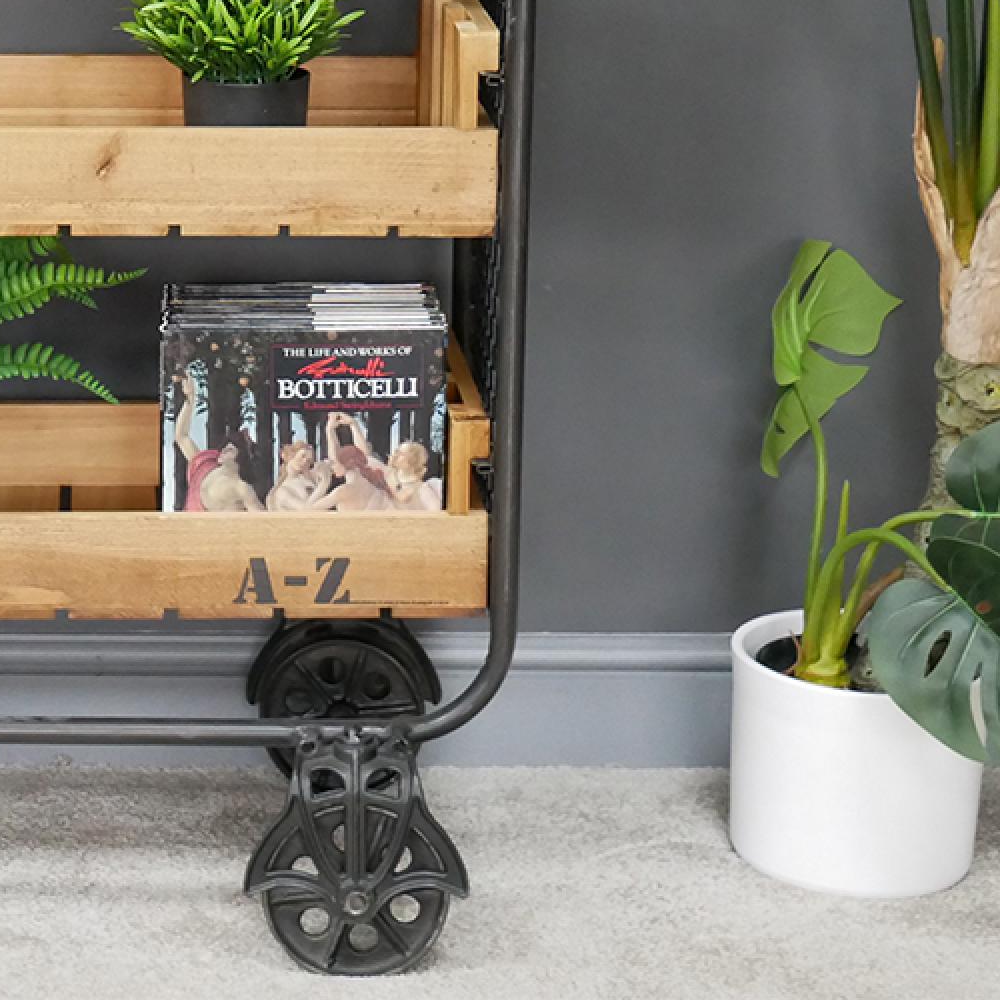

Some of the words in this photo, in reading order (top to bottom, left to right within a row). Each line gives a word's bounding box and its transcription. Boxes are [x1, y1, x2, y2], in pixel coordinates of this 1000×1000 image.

[282, 346, 306, 357] THE
[308, 346, 332, 357] LIFE
[332, 346, 357, 357] AND
[357, 346, 397, 357] WORKS
[397, 345, 412, 356] OF
[277, 377, 419, 399] BOTTICELLI
[232, 557, 350, 604] A-Z
